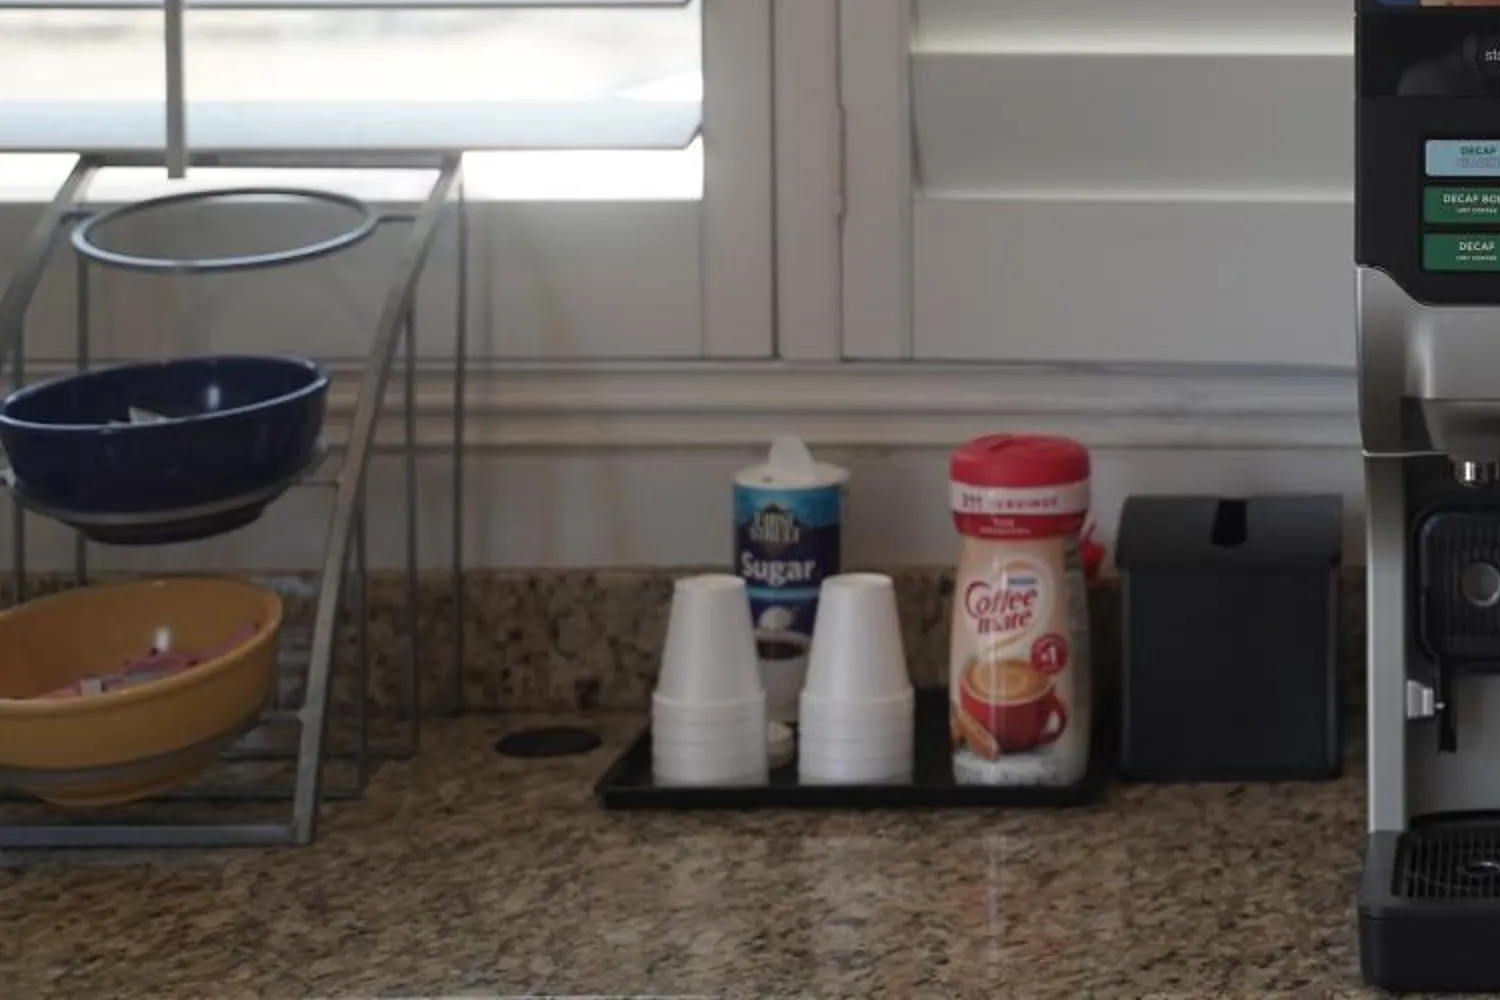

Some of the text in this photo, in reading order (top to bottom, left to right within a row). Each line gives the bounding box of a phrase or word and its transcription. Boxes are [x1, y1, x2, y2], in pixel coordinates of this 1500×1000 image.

[1459, 145, 1498, 156] DECAF
[1442, 193, 1479, 204] DECAF
[1458, 241, 1496, 251] DECAF
[741, 550, 817, 588] Sugar
[964, 580, 1038, 619] Coffee
[977, 611, 1033, 636] mate
